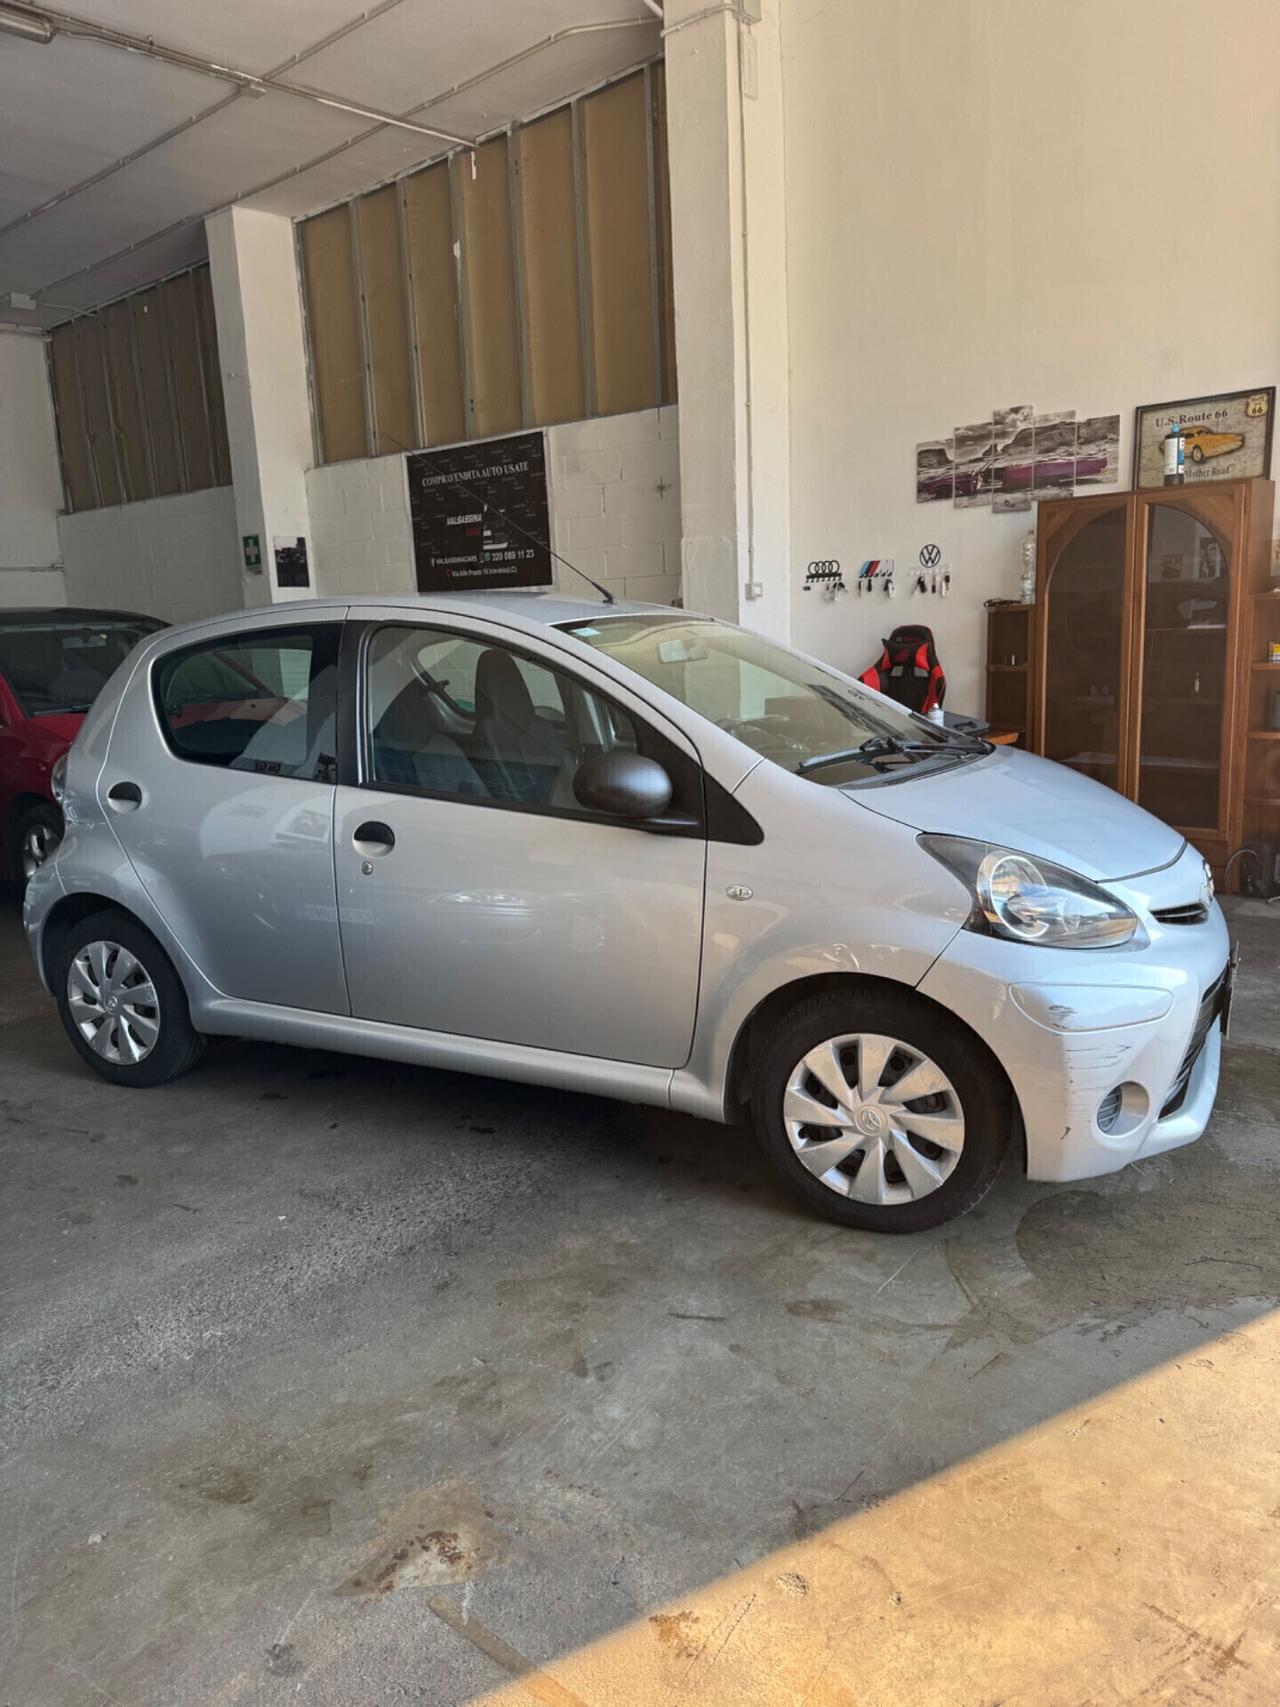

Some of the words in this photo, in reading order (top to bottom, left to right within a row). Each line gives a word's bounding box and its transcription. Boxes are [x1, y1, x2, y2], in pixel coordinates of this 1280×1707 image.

[1179, 413, 1212, 424] Route
[1214, 408, 1228, 419] 66
[1251, 406, 1263, 415] 66
[481, 465, 503, 478] AUTO
[503, 461, 529, 475] USATE
[492, 552, 503, 561] 320
[517, 551, 524, 559] 11
[526, 549, 534, 558] 23
